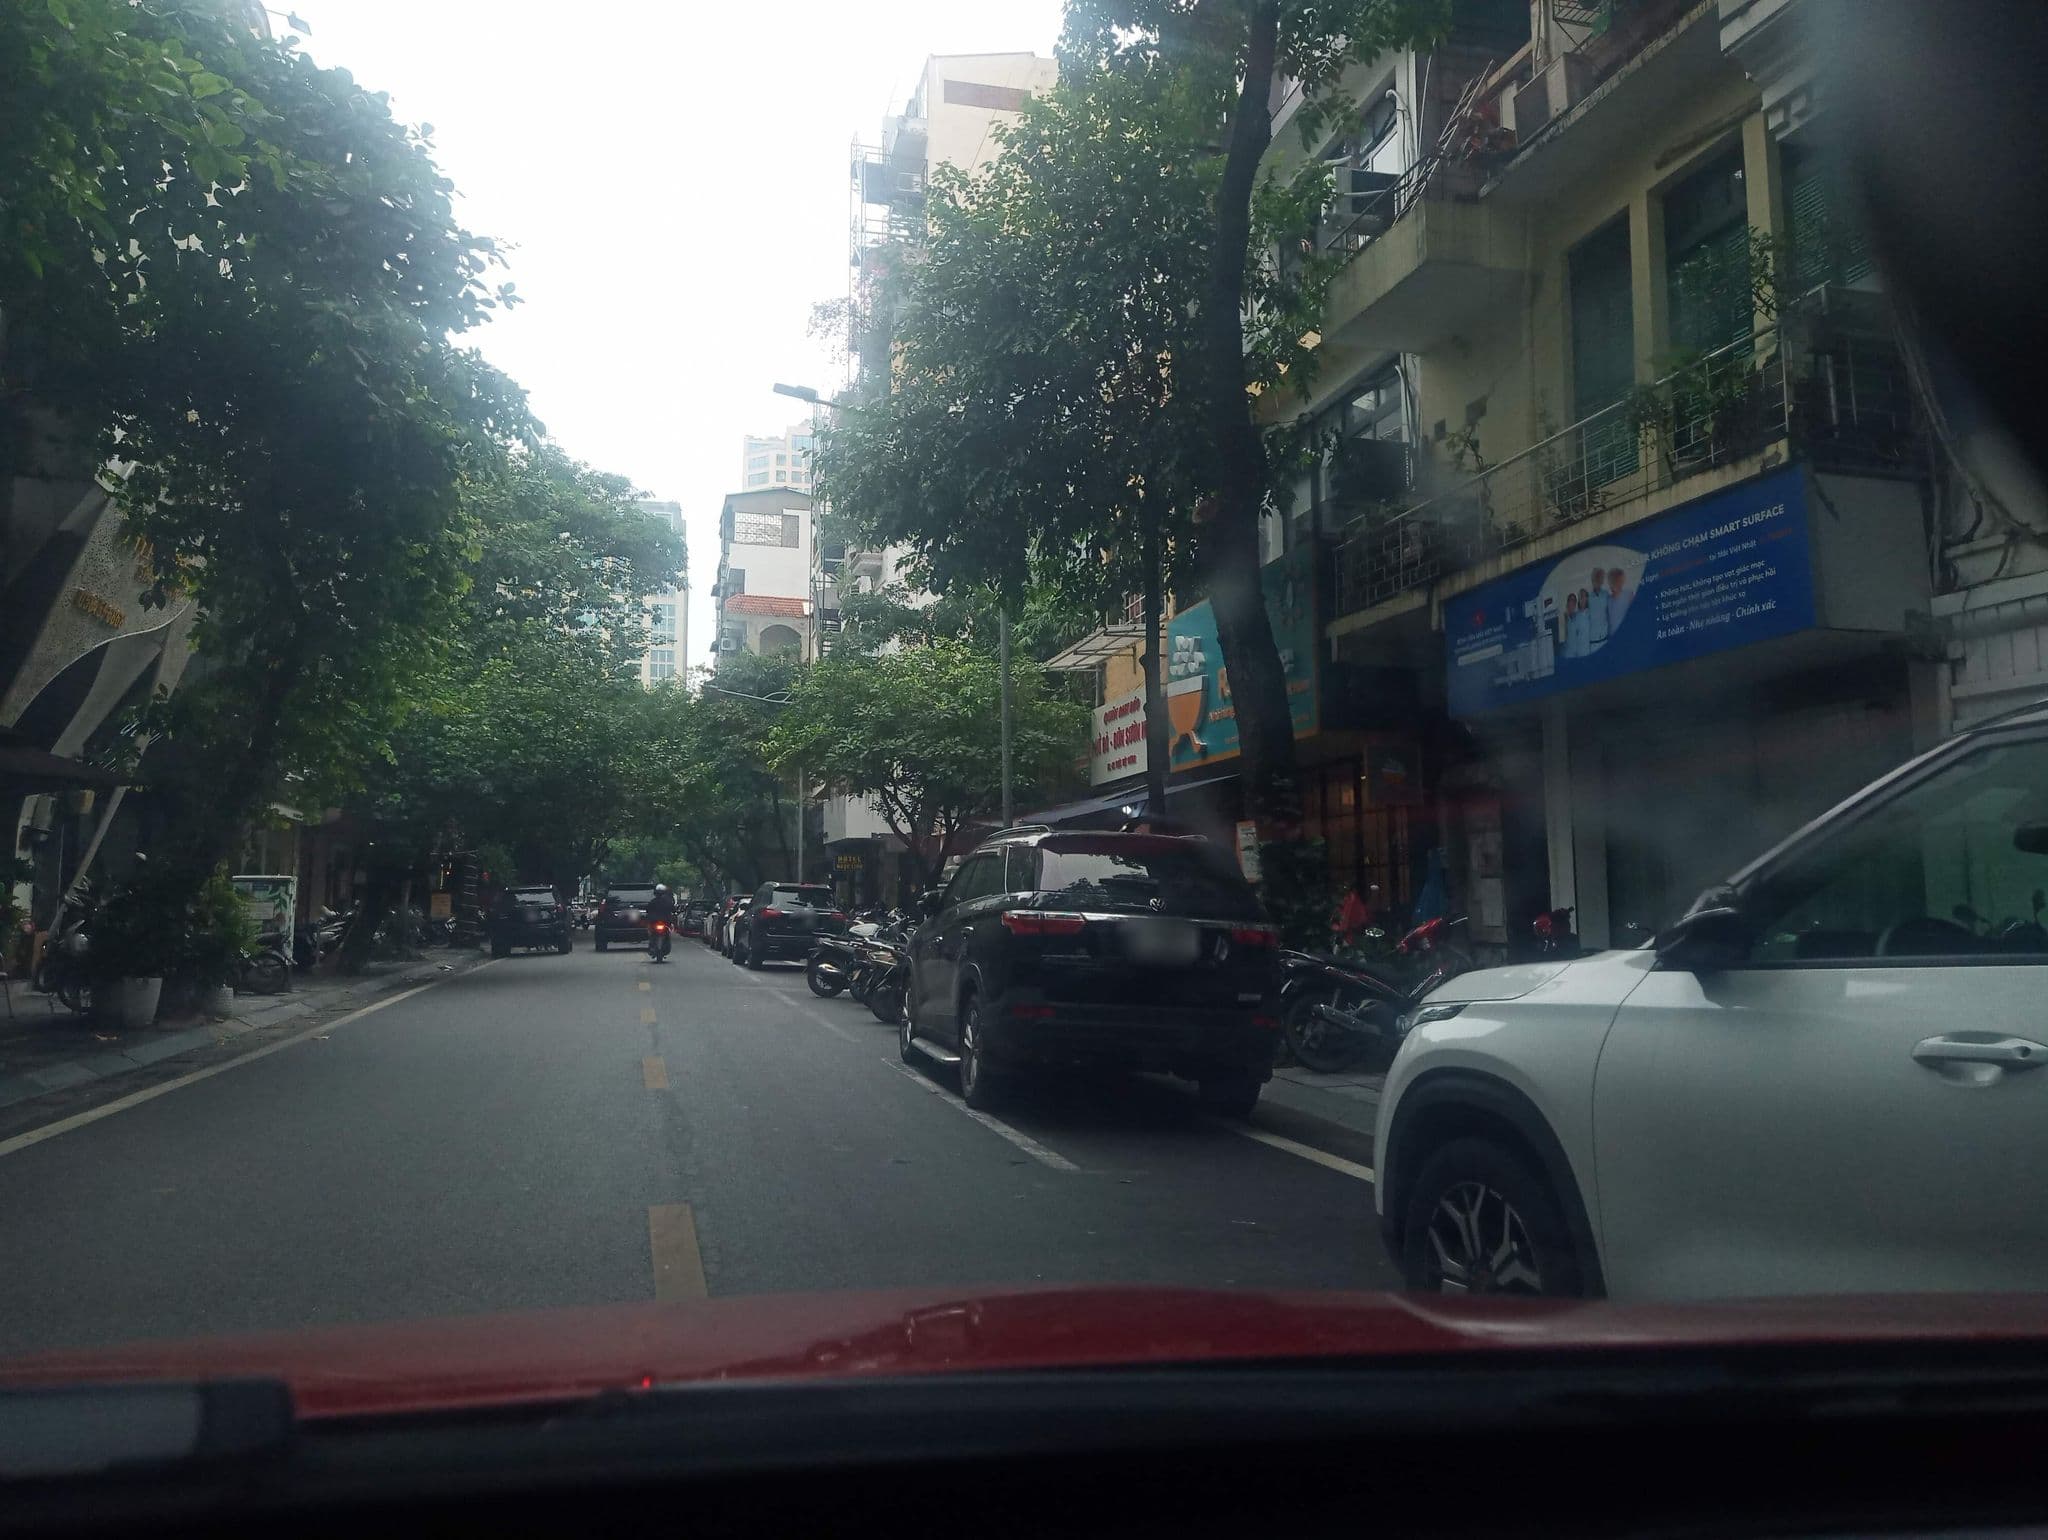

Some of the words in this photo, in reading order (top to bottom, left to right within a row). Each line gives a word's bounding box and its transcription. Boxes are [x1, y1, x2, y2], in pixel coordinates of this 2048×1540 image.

[1682, 530, 1709, 549] CHẠM
[1710, 520, 1741, 539] SMART
[1742, 504, 1785, 527] SURFACE
[1656, 629, 1667, 641] An
[1736, 603, 1760, 619] Chính
[1761, 598, 1777, 611] xác
